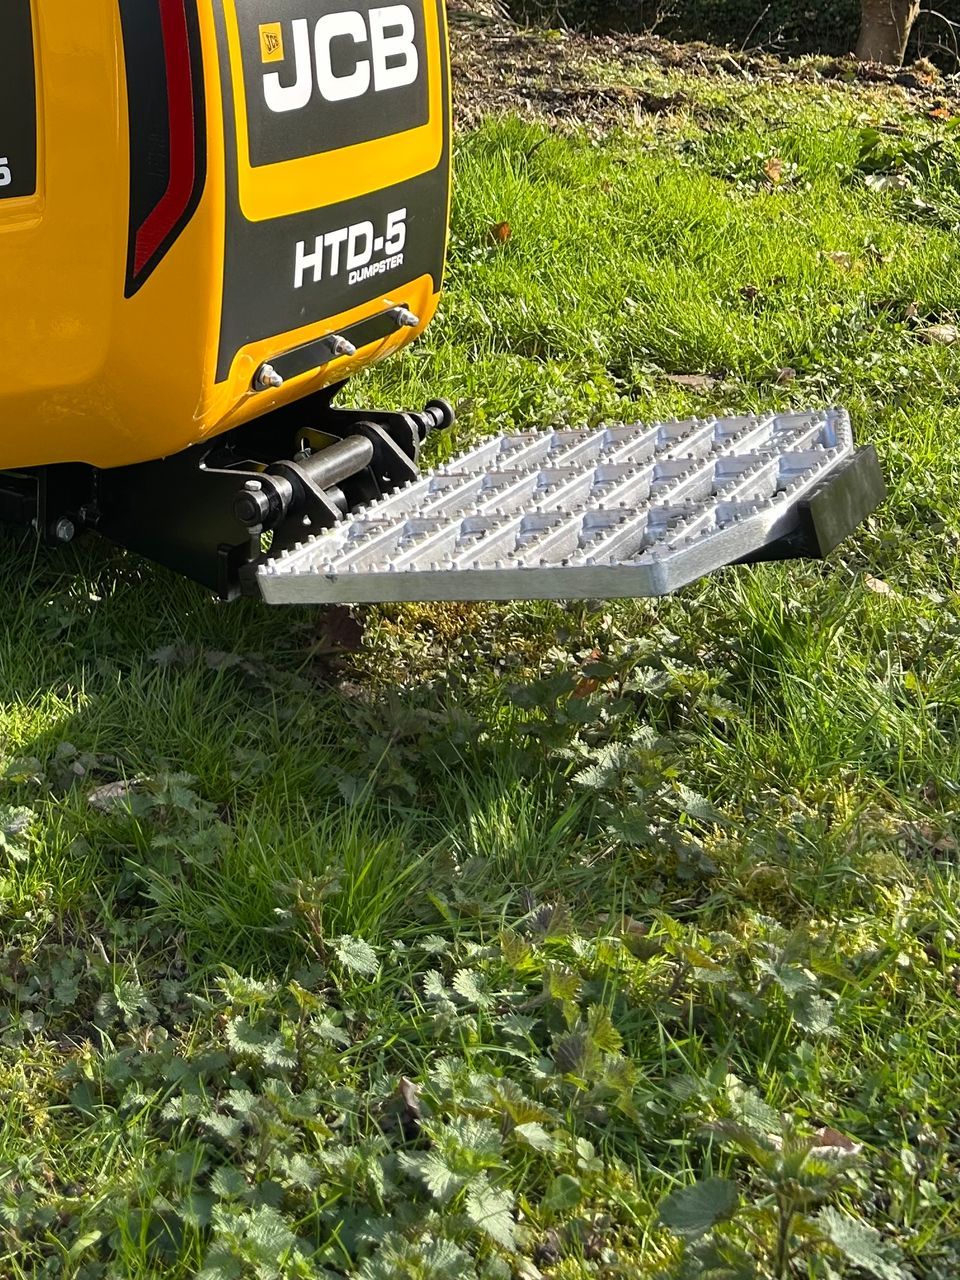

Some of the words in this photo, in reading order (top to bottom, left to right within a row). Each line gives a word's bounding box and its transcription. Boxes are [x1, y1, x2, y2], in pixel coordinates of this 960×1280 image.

[263, 4, 419, 113] JCB
[265, 33, 280, 51] JCB
[294, 207, 407, 289] HTD-5
[348, 253, 404, 285] DUMPSTER
